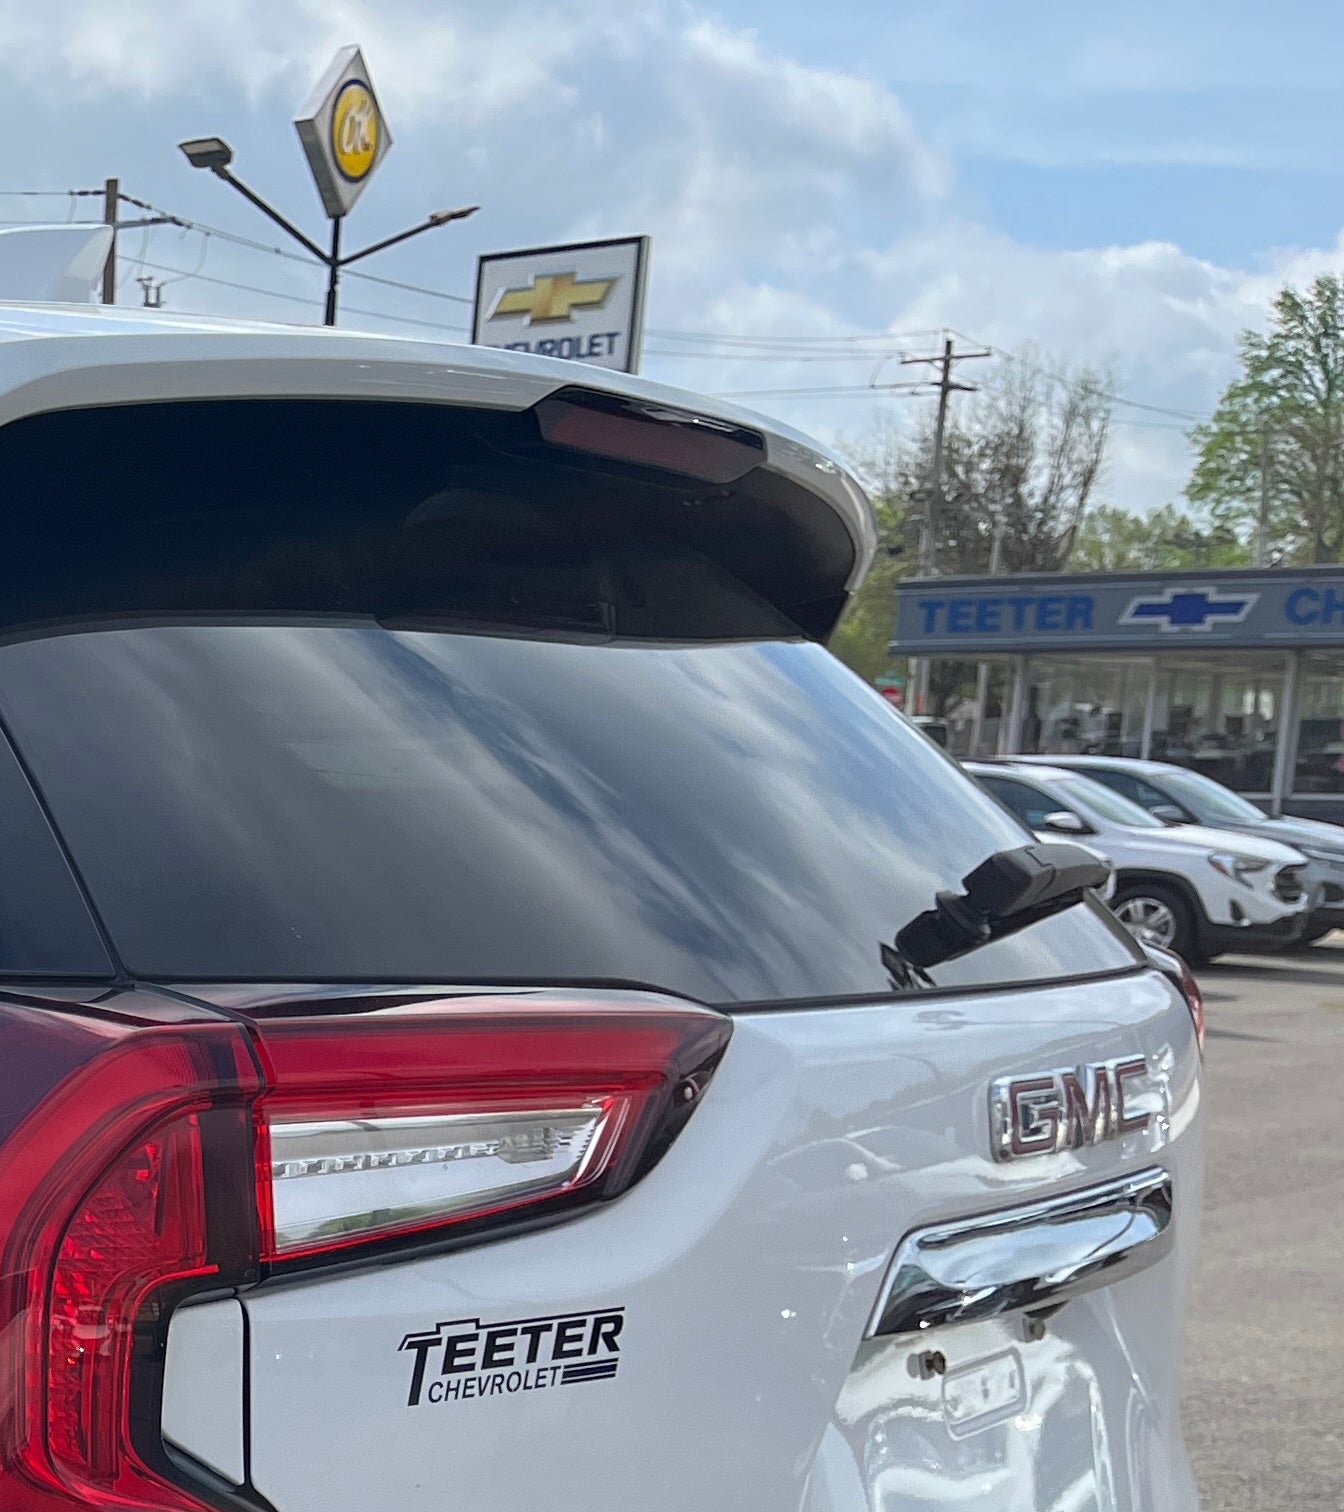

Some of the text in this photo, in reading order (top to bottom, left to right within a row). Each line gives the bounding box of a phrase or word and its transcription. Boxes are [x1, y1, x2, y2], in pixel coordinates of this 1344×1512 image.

[917, 595, 1096, 633] TEETER
[988, 1053, 1157, 1164] GMC
[404, 1314, 624, 1407] TEETER
[428, 1365, 562, 1404] CHEVROLET
